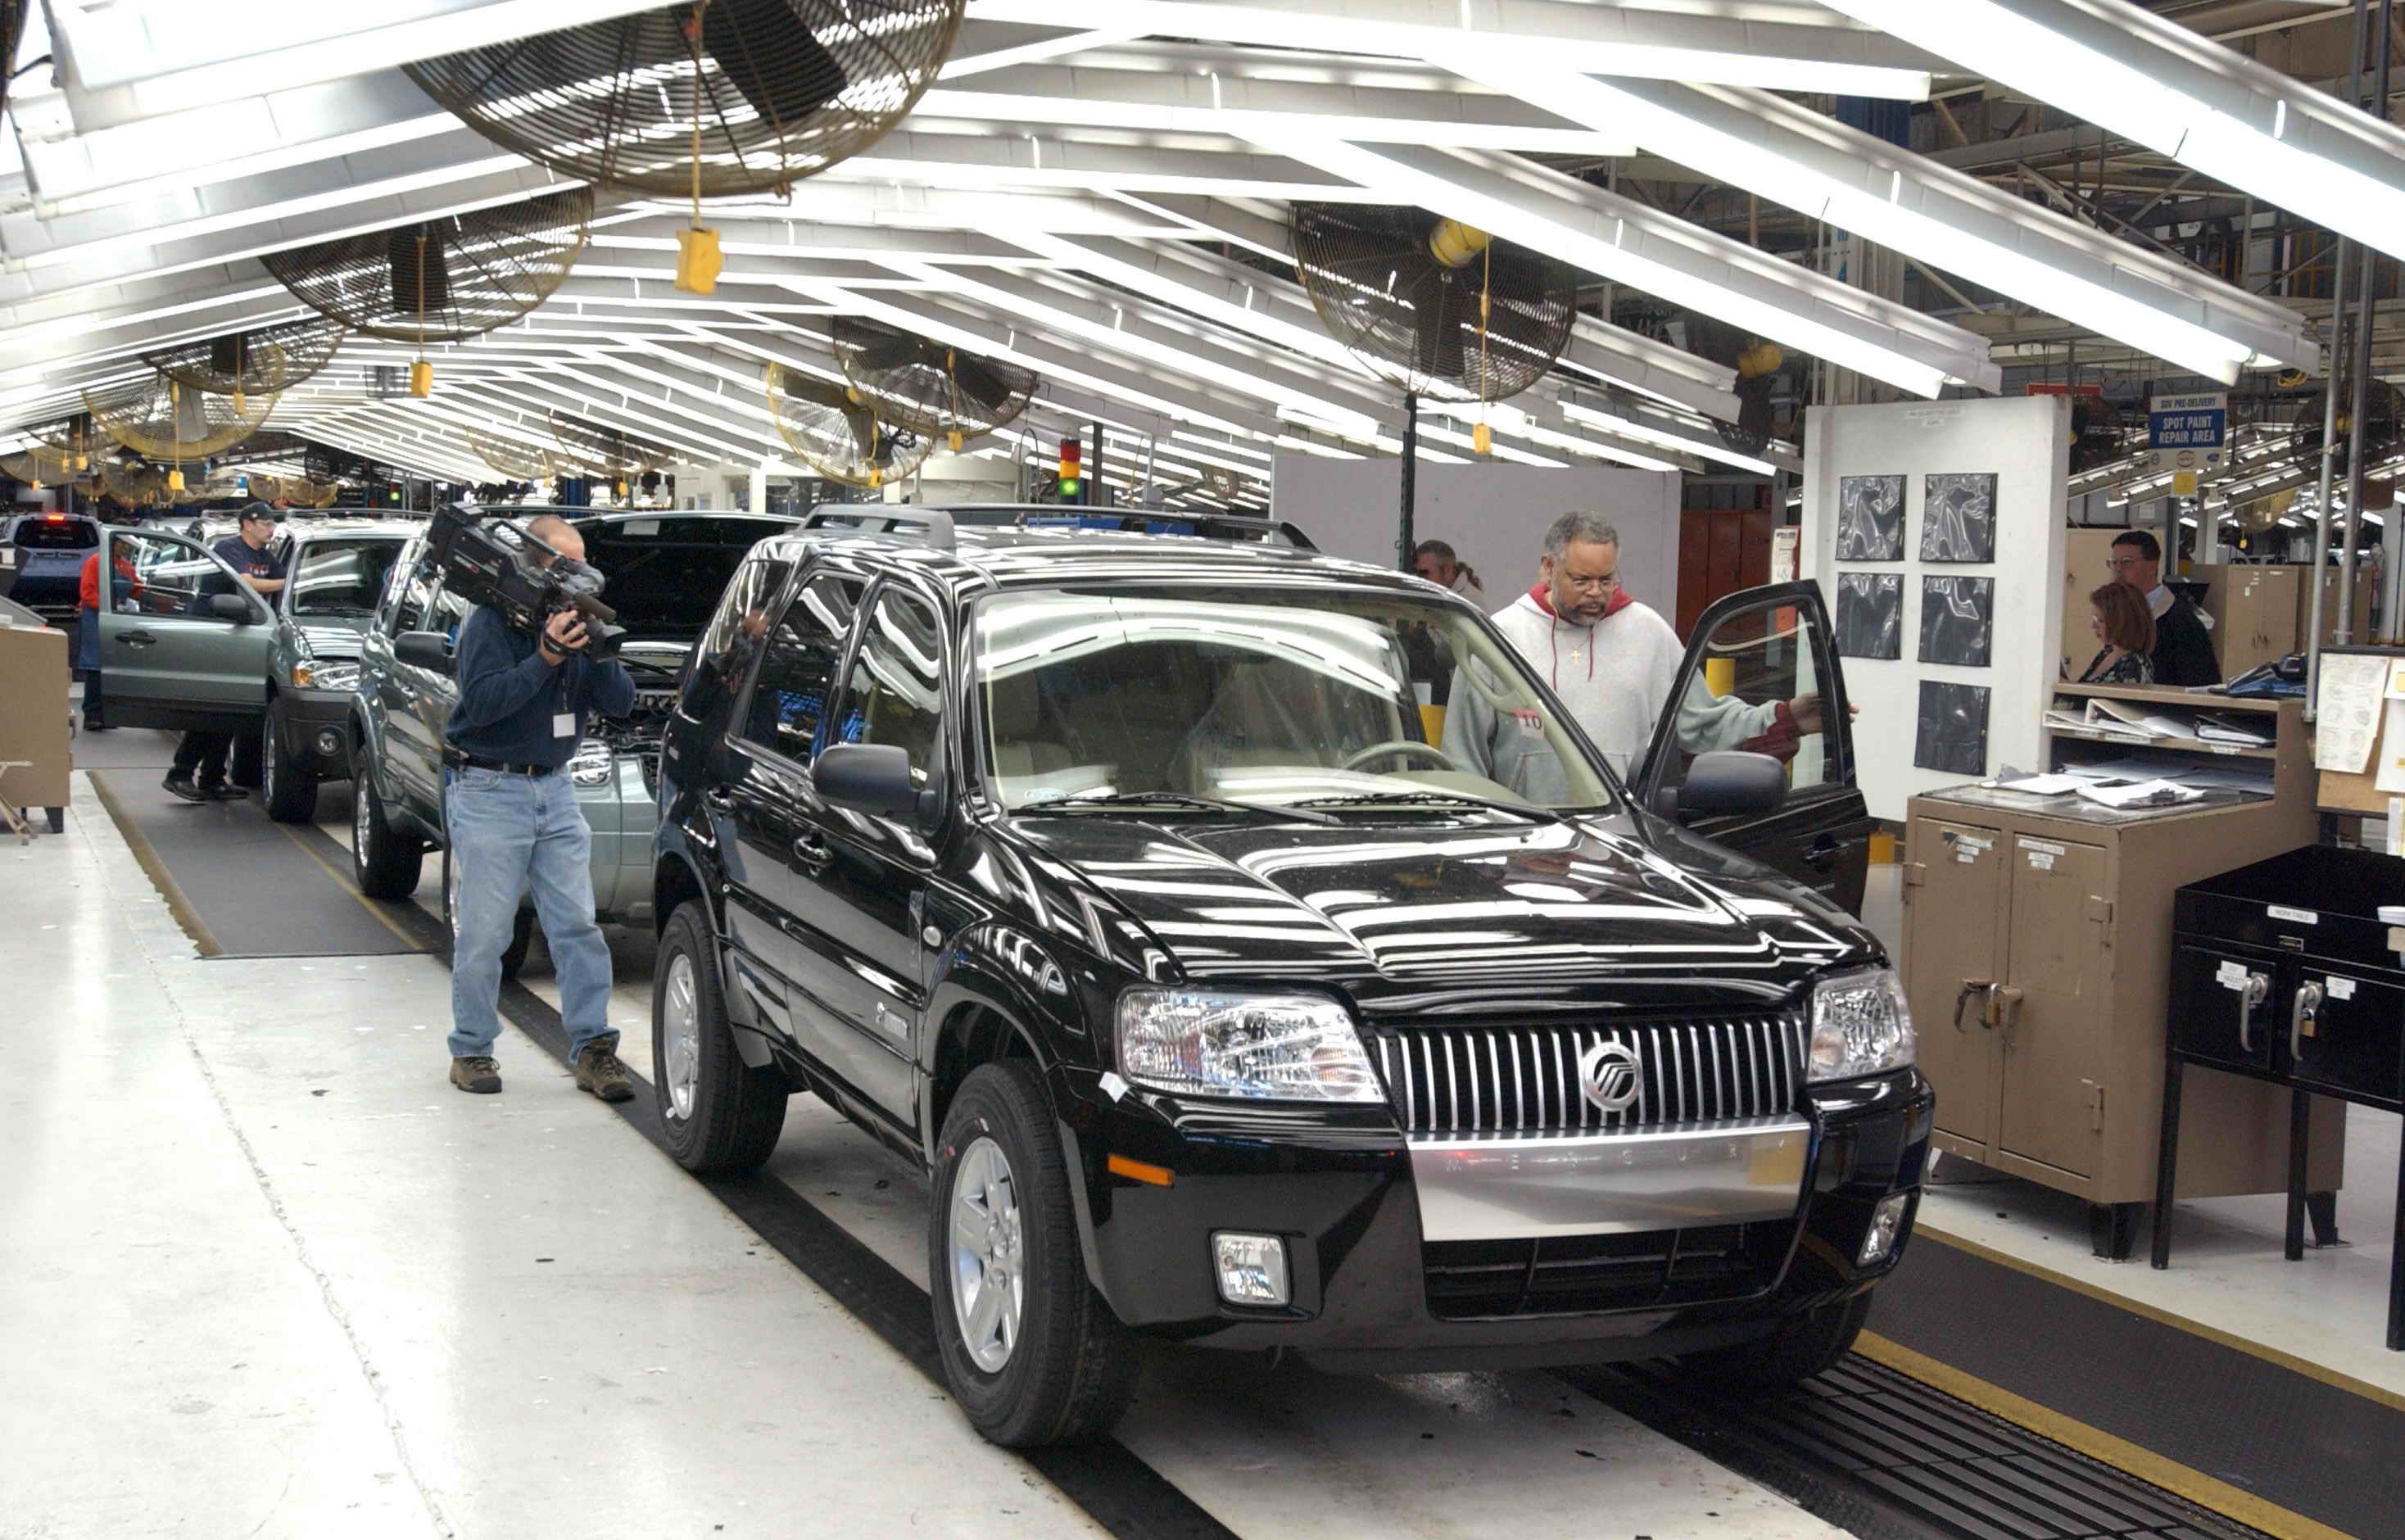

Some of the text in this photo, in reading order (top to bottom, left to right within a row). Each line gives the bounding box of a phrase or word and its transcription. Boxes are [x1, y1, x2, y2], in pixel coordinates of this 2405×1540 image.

[2176, 397, 2216, 407] PRE-DELIVERY
[2163, 415, 2213, 429] SPOT PAINT
[2158, 429, 2216, 444] REPAIR AREA
